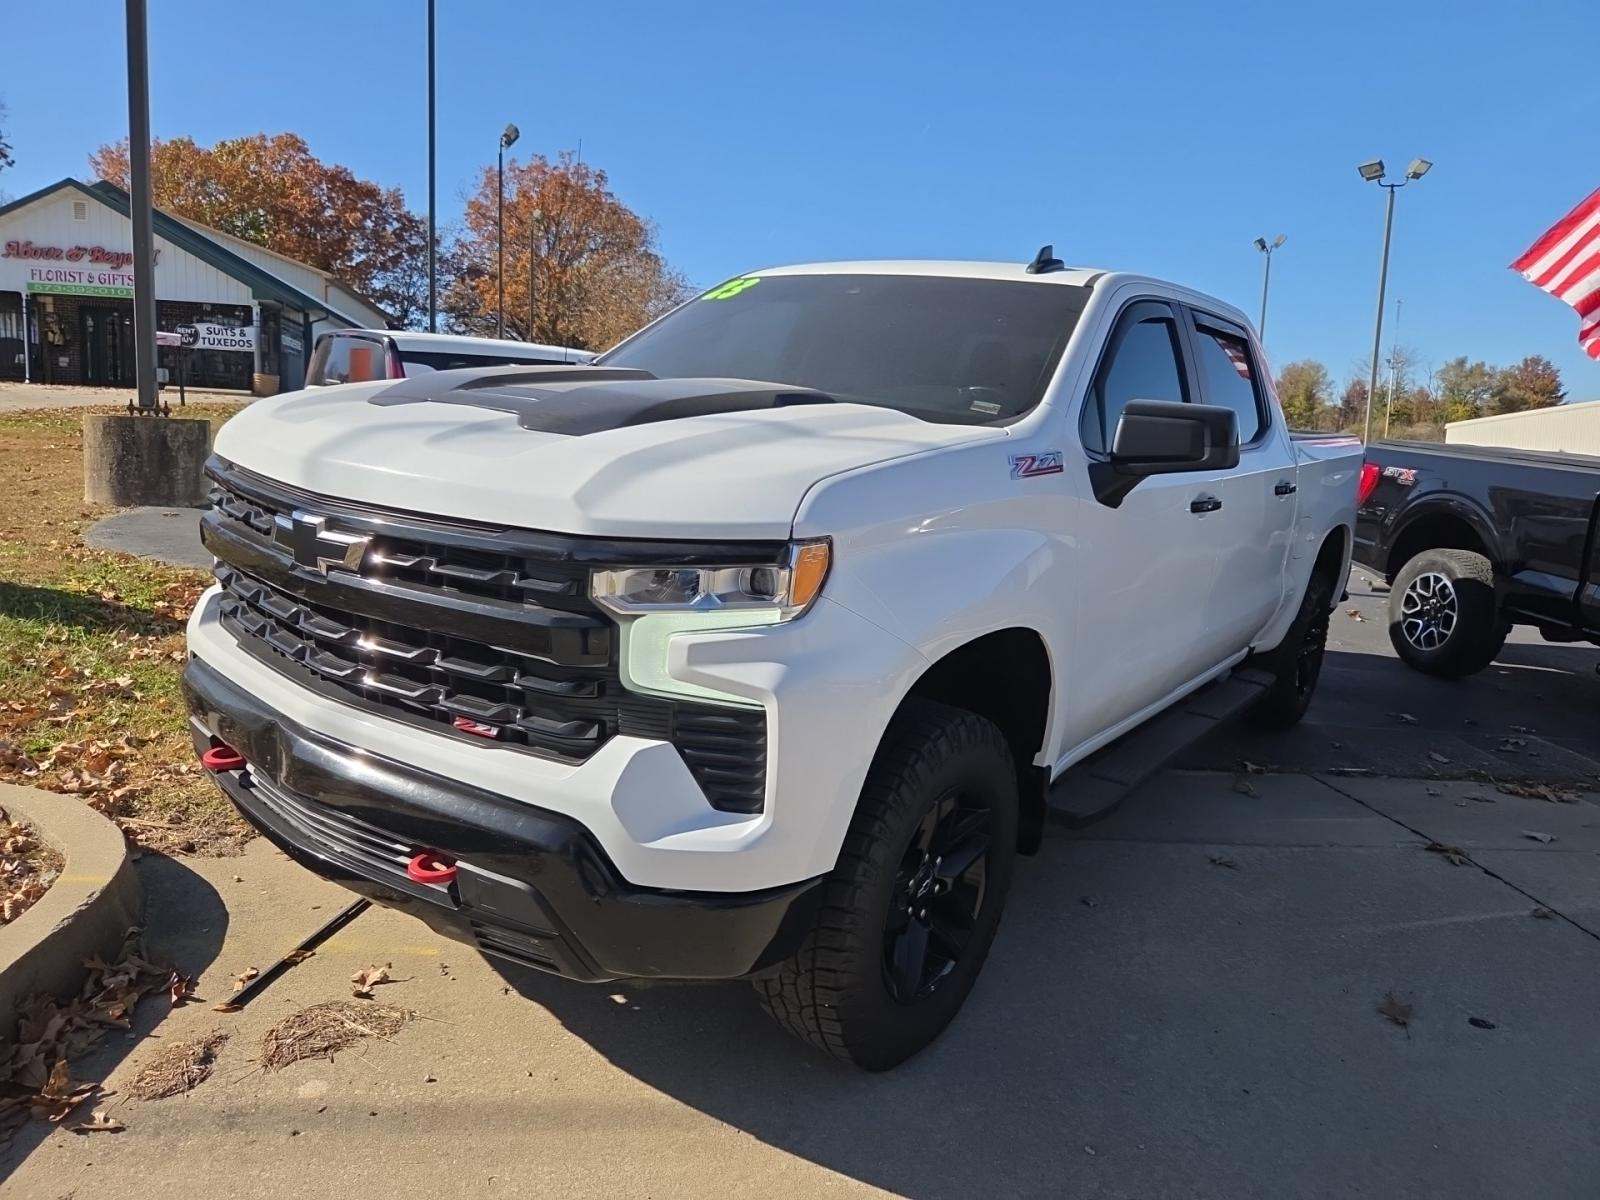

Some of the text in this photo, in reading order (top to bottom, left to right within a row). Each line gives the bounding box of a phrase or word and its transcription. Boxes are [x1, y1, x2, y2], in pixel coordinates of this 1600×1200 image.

[1, 240, 63, 260] Above
[65, 246, 87, 262] &
[31, 269, 135, 286] FLORIST & GIFTS
[206, 326, 247, 338] SUITS &
[201, 336, 253, 348] TUXEDOS
[1009, 451, 1064, 480] Z71
